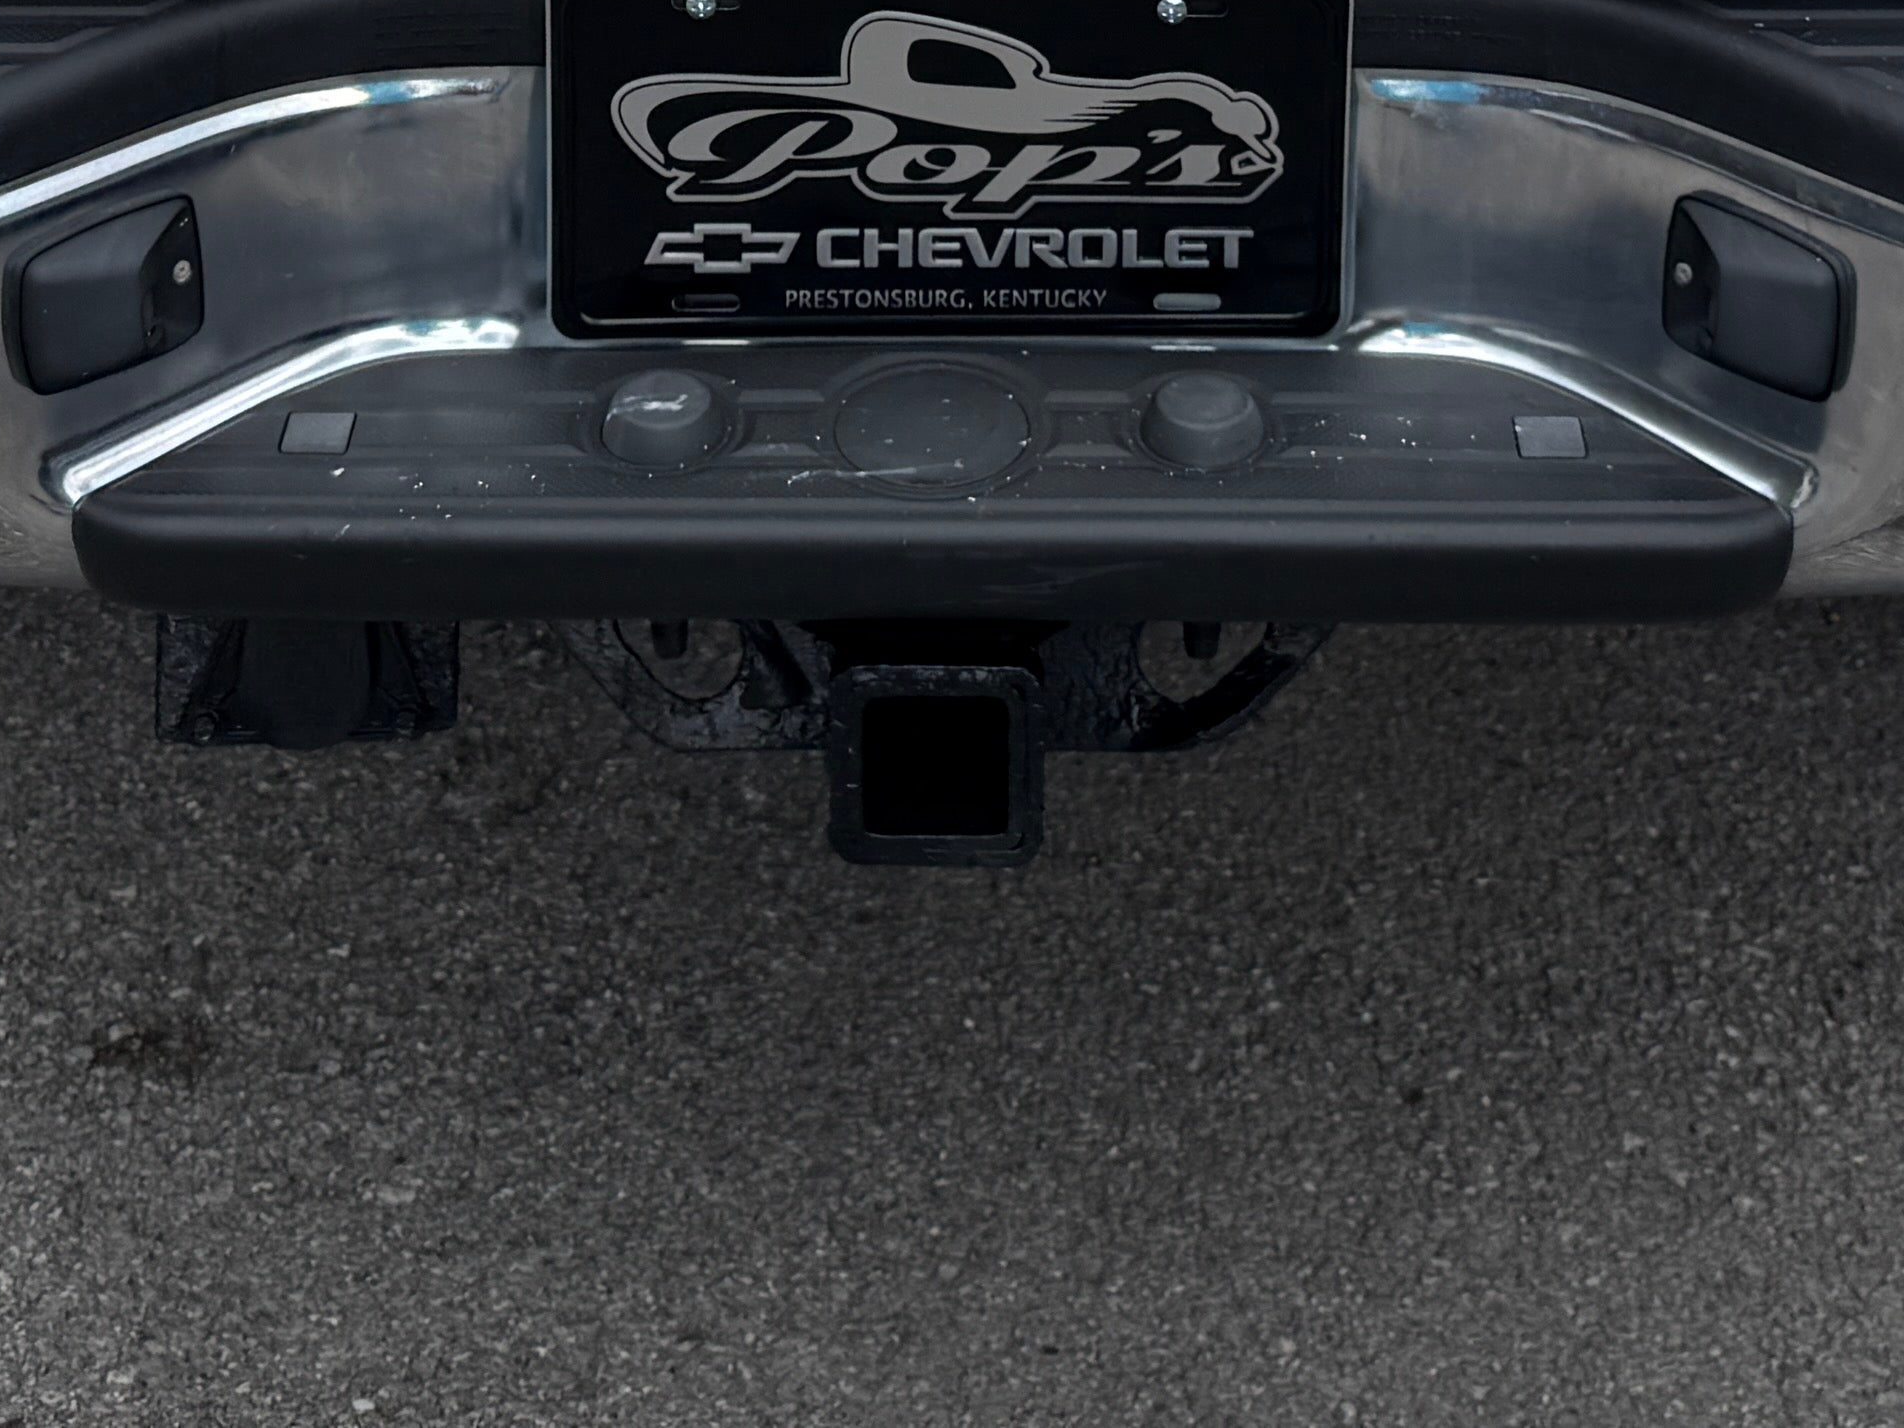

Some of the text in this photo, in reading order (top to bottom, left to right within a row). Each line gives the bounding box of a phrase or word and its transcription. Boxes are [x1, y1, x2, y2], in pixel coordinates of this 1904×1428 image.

[666, 108, 1246, 204] Pop's
[815, 227, 1255, 270] CHEVROLET
[784, 289, 1108, 310] PRESTONSBURG, KENTUCKY
